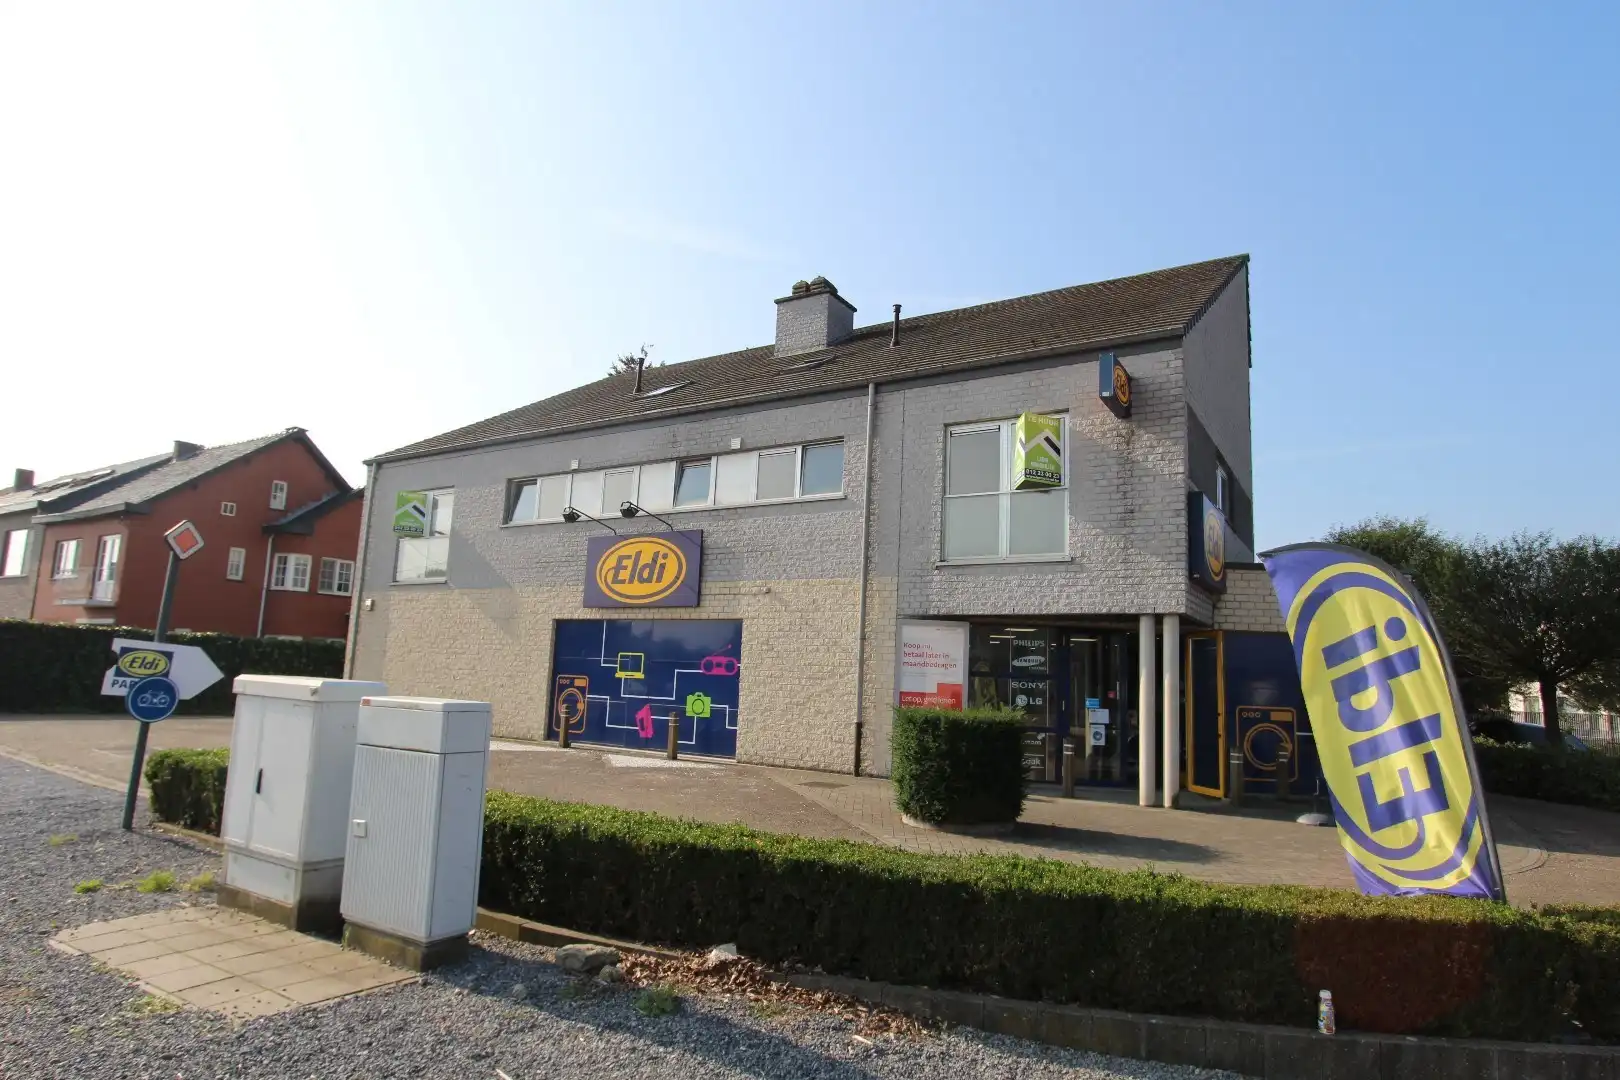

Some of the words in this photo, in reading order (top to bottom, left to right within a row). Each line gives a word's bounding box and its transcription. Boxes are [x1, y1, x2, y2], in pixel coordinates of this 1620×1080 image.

[610, 550, 669, 585] Eldi
[903, 642, 921, 650] Koop
[1013, 639, 1045, 647] PHILIPS
[925, 651, 941, 659] later
[128, 655, 161, 671] Eldi
[902, 660, 957, 670] maandbedragen
[111, 679, 138, 689] PAR
[1029, 697, 1043, 705] LG
